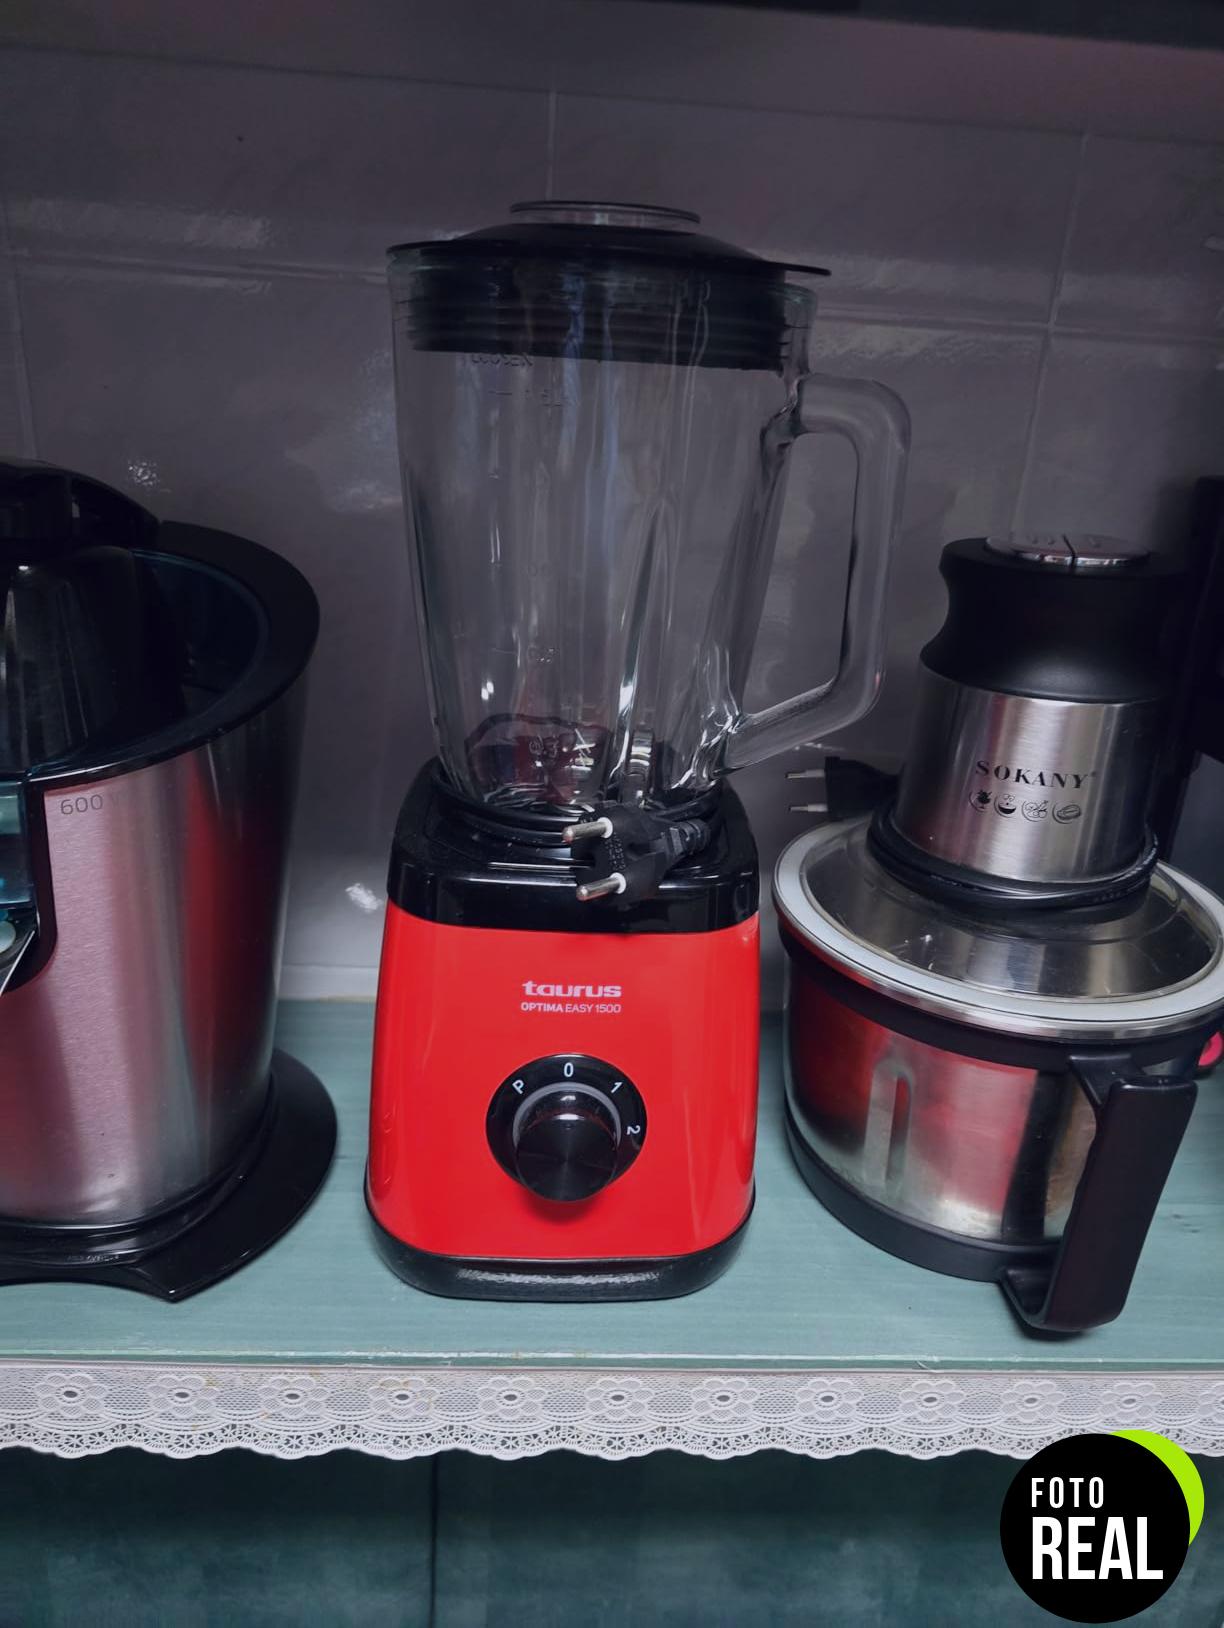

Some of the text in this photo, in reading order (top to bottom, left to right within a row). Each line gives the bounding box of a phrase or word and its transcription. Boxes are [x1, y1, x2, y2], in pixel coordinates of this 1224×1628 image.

[975, 760, 1089, 789] SOKANY
[60, 794, 104, 815] 600
[522, 980, 622, 998] taurus
[520, 1001, 621, 1014] OPTIMA EASY 1500
[512, 1079, 524, 1095] P
[610, 1081, 623, 1094] 1
[626, 1125, 641, 1135] 2
